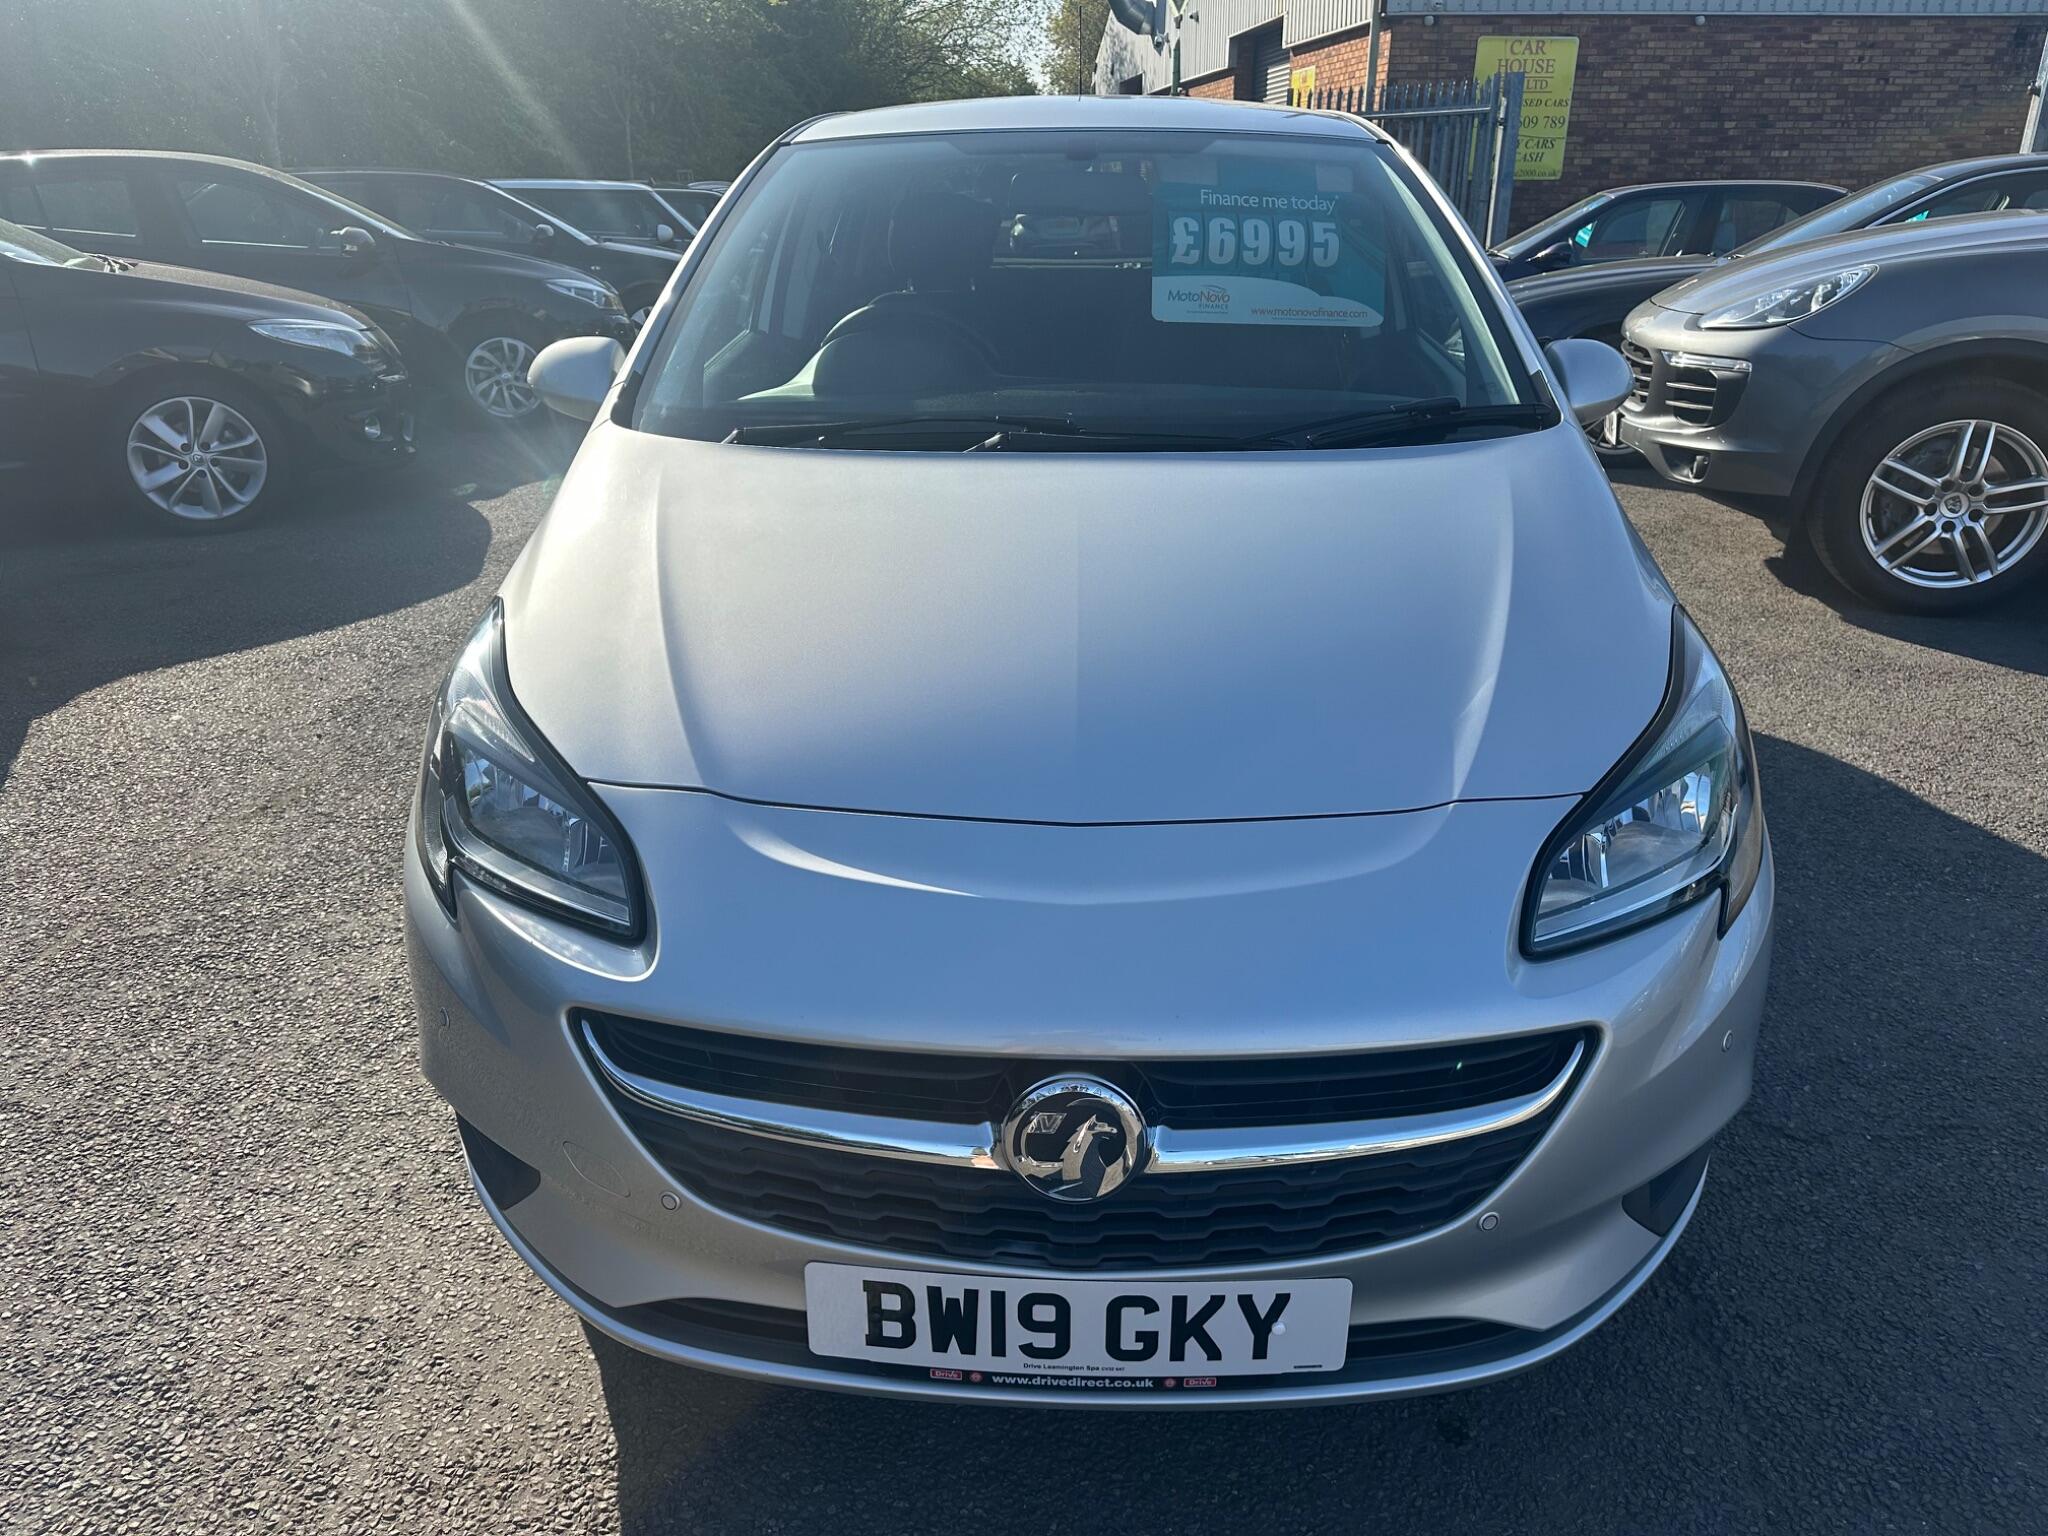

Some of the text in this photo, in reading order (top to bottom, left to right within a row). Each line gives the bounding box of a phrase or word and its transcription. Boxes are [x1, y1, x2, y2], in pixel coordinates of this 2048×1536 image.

[1510, 40, 1546, 55] CAR
[1497, 59, 1555, 73] HOUSE
[1526, 79, 1548, 90] LTD
[1522, 98, 1543, 108] SED
[1543, 115, 1566, 129] 789
[1524, 139, 1555, 149] CARS
[1200, 189, 1259, 208] Finance
[1263, 197, 1288, 209] me
[1171, 216, 1340, 267] £6995
[1167, 289, 1230, 303] MotoNovo
[1251, 307, 1368, 318] www.motonovofinance.com
[1105, 1292, 1292, 1362] GKY
[992, 1374, 1154, 1388] www.drivedirect.co.uk
